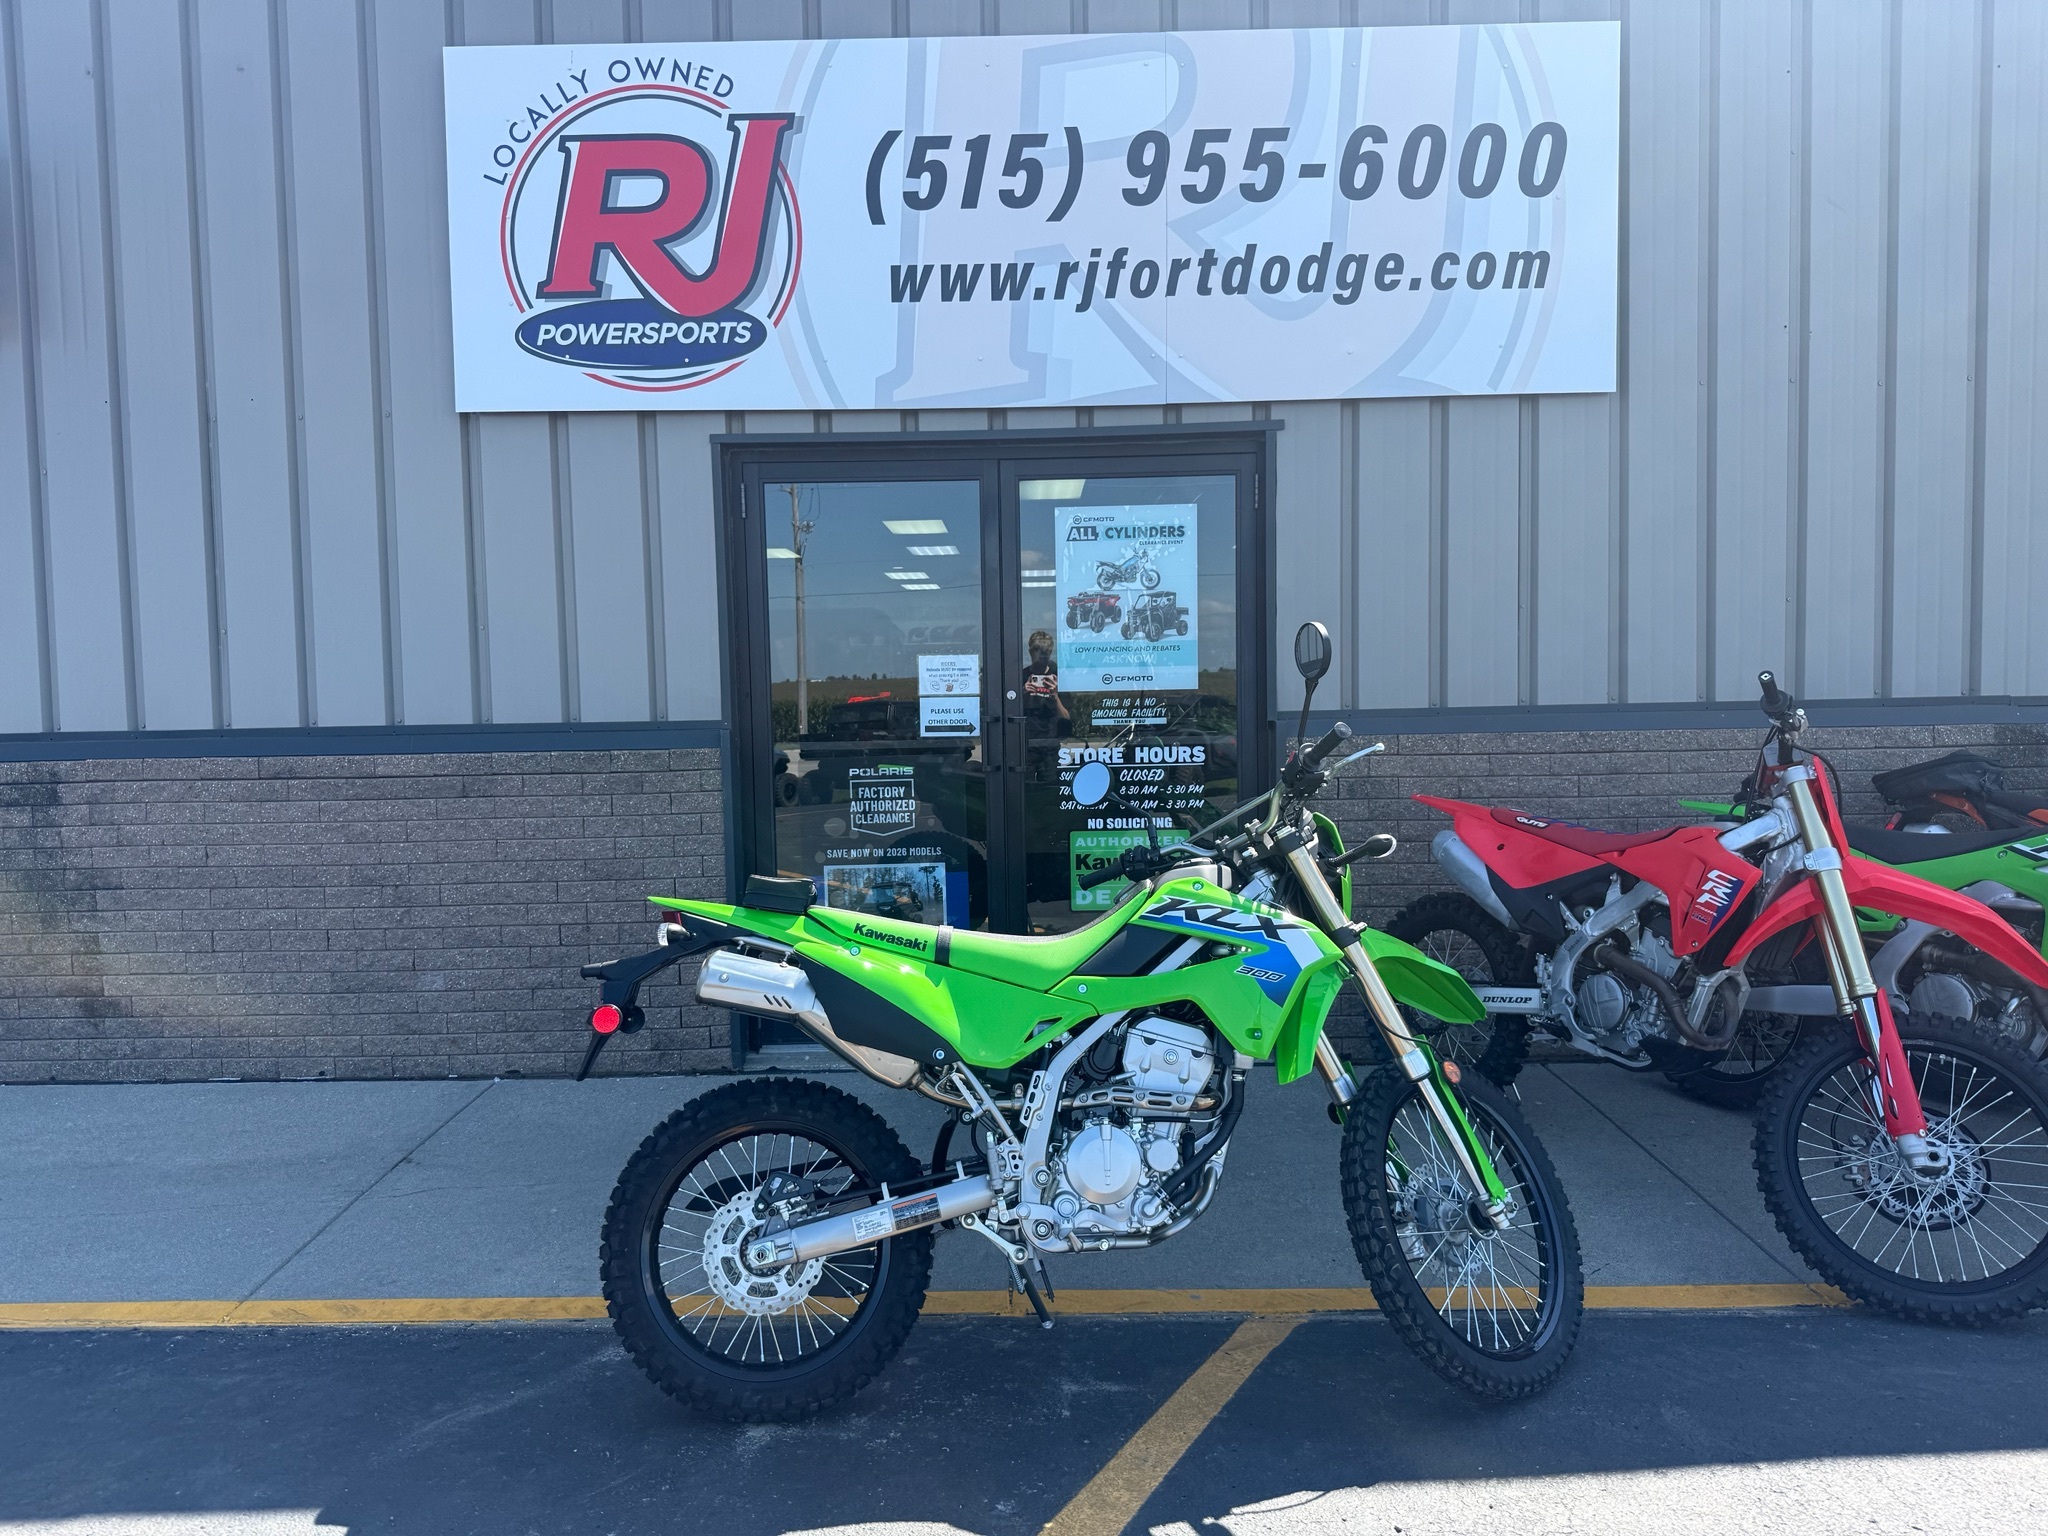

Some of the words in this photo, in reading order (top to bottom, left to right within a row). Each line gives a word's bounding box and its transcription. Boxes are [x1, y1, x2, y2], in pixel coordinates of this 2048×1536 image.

[483, 67, 591, 187] LOCALLY
[607, 56, 735, 99] OWNED
[865, 126, 1084, 226] (515)
[1121, 121, 1568, 207] 955-6000
[536, 112, 796, 317] RJ
[889, 241, 1551, 313] www.rjfortdodge.com
[536, 320, 753, 346] POWERSPORTS
[1068, 526, 1097, 541] ALL
[1104, 525, 1186, 540] CYLINDERS
[1151, 644, 1181, 652] REBATES
[1102, 698, 1119, 707] THIS
[1122, 698, 1131, 707] IS
[1134, 698, 1140, 707] A
[1144, 697, 1156, 706] NO
[1091, 709, 1128, 718] SMOKING
[1131, 707, 1167, 717] FACILITY
[1057, 746, 1124, 765] STORE
[1134, 746, 1206, 763] HOURS
[849, 767, 914, 777] POLARIS
[1119, 768, 1165, 782] CLOSED
[858, 786, 906, 799] FACTORY
[1140, 785, 1158, 795] AM
[1187, 784, 1205, 794] PM
[850, 799, 916, 813] AUTHORIZED
[1140, 799, 1158, 810] AM
[1187, 799, 1205, 809] PM
[855, 812, 911, 824] CLEARANCE
[1087, 818, 1104, 830] NO
[826, 848, 848, 858] SAVE
[850, 848, 871, 858] NOW
[873, 848, 884, 857] ON
[886, 847, 907, 856] 2026
[909, 846, 942, 856] MODELS
[1143, 896, 1309, 943] KLX
[853, 922, 928, 952] Kawasaki
[1235, 965, 1286, 983] 300
[1481, 995, 1533, 1004] DUNLOP
